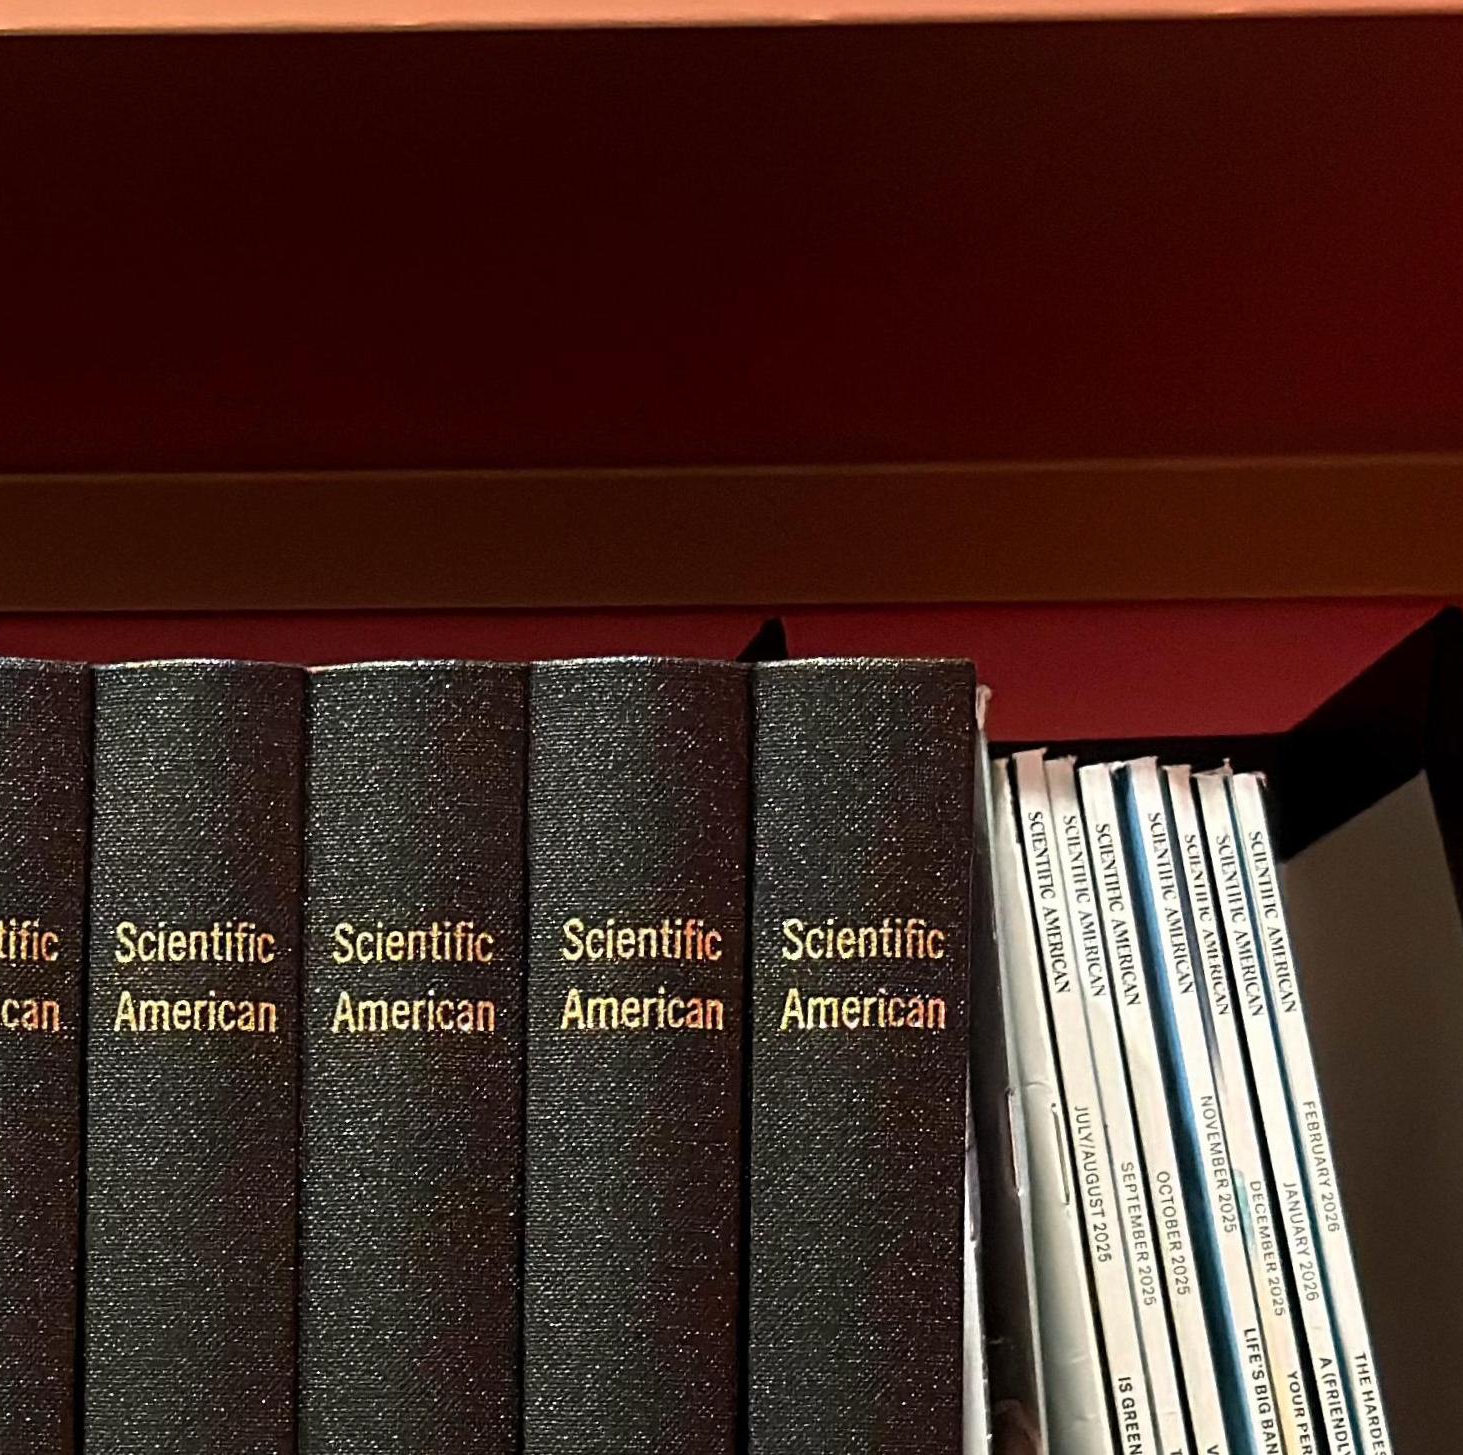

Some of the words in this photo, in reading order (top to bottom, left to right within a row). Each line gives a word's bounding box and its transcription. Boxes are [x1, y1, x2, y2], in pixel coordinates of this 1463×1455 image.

[119, 923, 276, 964] Scientific
[786, 919, 946, 960] Scientific
[1028, 811, 1056, 899] SCIENTIFIC
[1042, 906, 1071, 993] AMERICAN
[1063, 815, 1091, 903] SCIENTIFIC
[1078, 911, 1106, 997] AMERICAN
[1095, 823, 1124, 912] SCIENTIFIC
[1111, 919, 1141, 1006] AMERICAN
[1148, 812, 1176, 900] SCIENTIFIC
[1164, 908, 1195, 994] AMERICAN
[1184, 834, 1212, 921] SCIENTIFIC
[1202, 929, 1229, 1015] AMERICAN
[1216, 834, 1246, 923] SCIENTIFIC
[1234, 930, 1263, 1016] AMERICAN
[1248, 831, 1278, 918] SCIENTIFIC
[1267, 927, 1296, 1013] AMERICAN
[116, 994, 277, 1033] American
[781, 990, 946, 1031] American
[1074, 1106, 1106, 1218] JULY/AUGUST
[1093, 1222, 1112, 1262] 2025
[1201, 1095, 1229, 1189] NOVEMBER
[1218, 1194, 1237, 1233] 2025
[1303, 1101, 1331, 1187] FEBRUARY
[1321, 1192, 1340, 1232] 2026
[1121, 1162, 1149, 1262] SEPTEMBER
[1138, 1265, 1157, 1306] 2025
[1156, 1171, 1182, 1251] OCTOBER
[1171, 1255, 1190, 1295] 2025
[1250, 1181, 1277, 1273] DECEMBER
[1268, 1277, 1285, 1316] 2025
[1283, 1183, 1310, 1256] JANUARY
[1299, 1261, 1319, 1301] 2026
[1118, 1376, 1133, 1393] IS
[1243, 1328, 1265, 1381] LIFE'S
[1254, 1384, 1271, 1414] BIG
[1287, 1371, 1305, 1418] YOUR
[1319, 1357, 1333, 1369] A
[1354, 1352, 1372, 1386] THE
